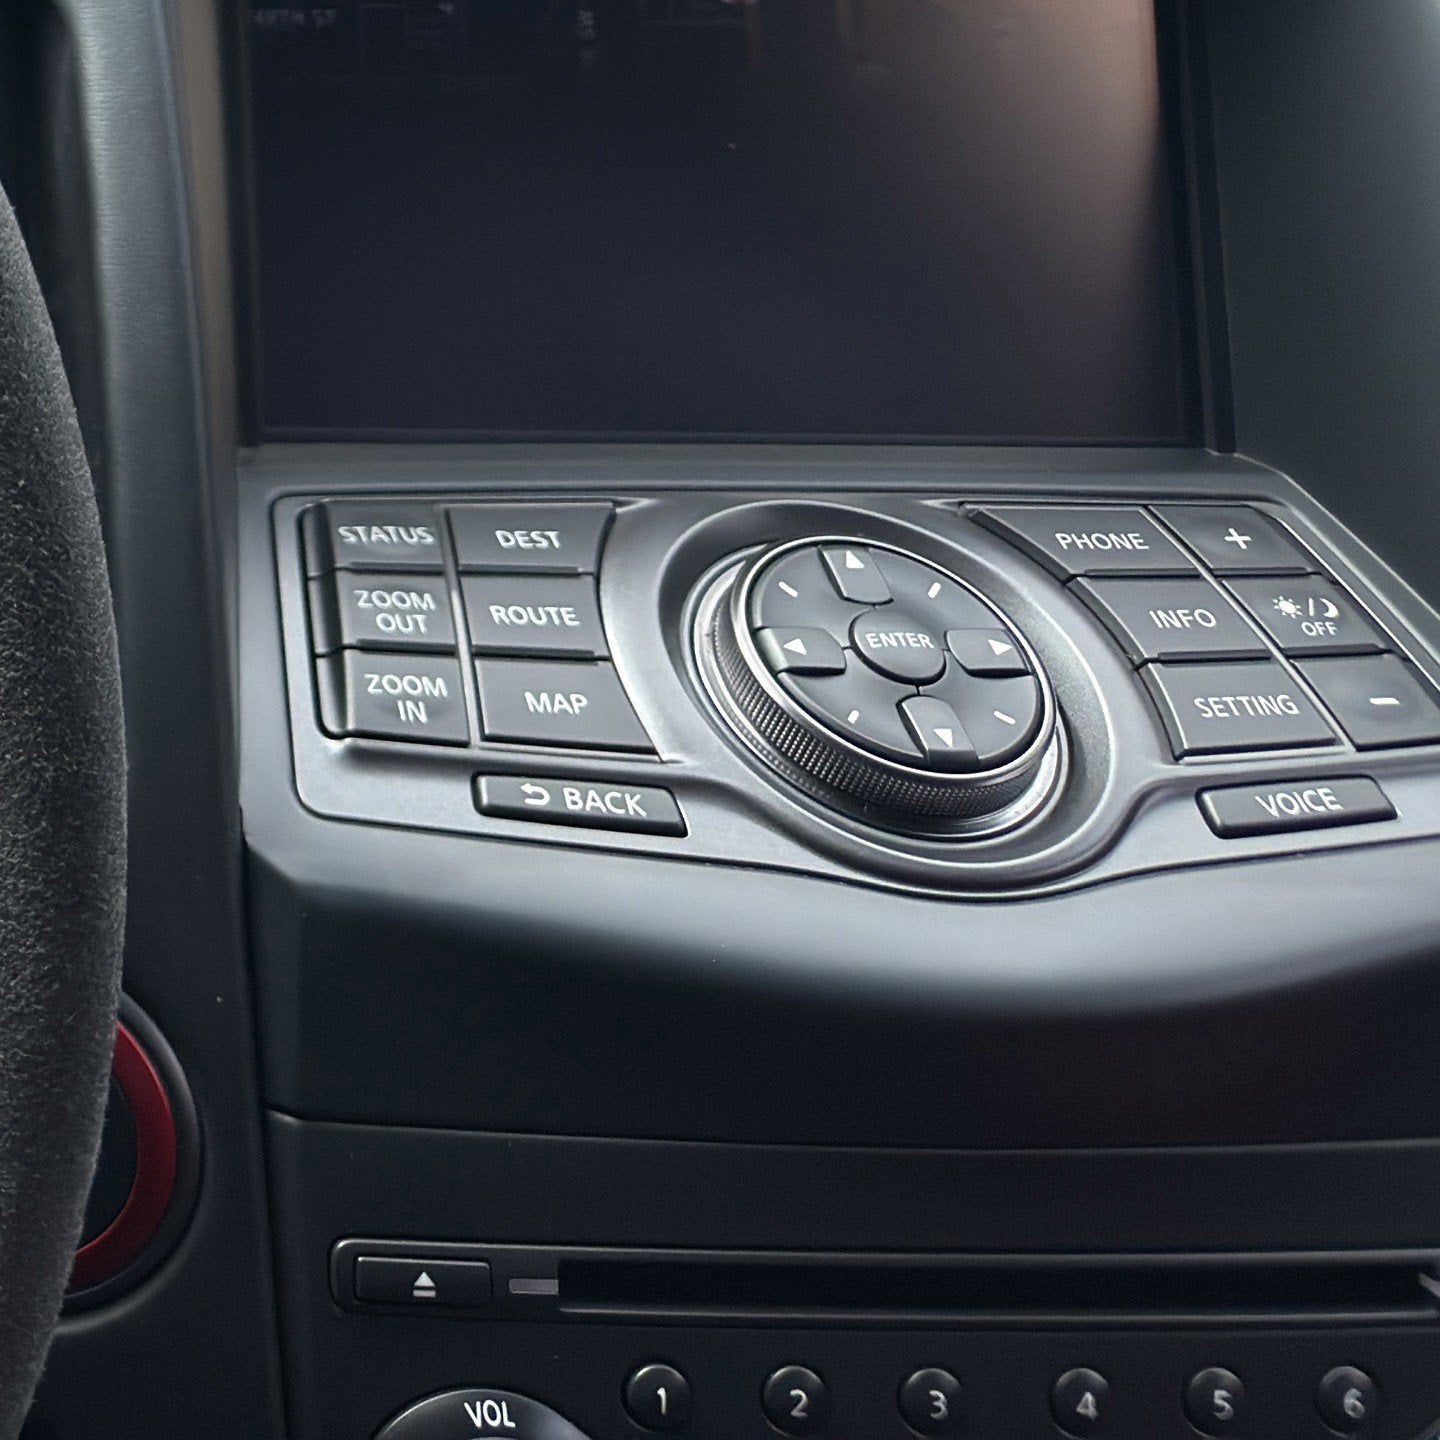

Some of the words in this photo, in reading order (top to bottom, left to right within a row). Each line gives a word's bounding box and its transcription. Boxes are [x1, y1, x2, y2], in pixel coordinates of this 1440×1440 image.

[338, 525, 435, 545] STATUS
[495, 529, 562, 549] DEST
[1055, 531, 1149, 552] PHONE
[354, 590, 436, 611] ZOOM
[375, 614, 429, 634] OUT
[489, 605, 580, 627] ROUTE
[1149, 608, 1217, 629] INFO
[1301, 621, 1338, 637] OFF
[866, 632, 935, 651] ENTER
[366, 675, 448, 697] ZOOM
[397, 701, 428, 723] IN
[524, 692, 588, 716] MAP
[1193, 695, 1300, 720] SETTING
[564, 788, 647, 817] BACK
[1253, 788, 1344, 818] VOICE
[657, 1387, 668, 1415] 1
[790, 1389, 809, 1418] 2
[929, 1389, 948, 1419] 3
[1076, 1391, 1099, 1420] 4
[1213, 1389, 1234, 1420] 5
[1344, 1388, 1365, 1419] 6
[464, 1399, 516, 1429] VOL
